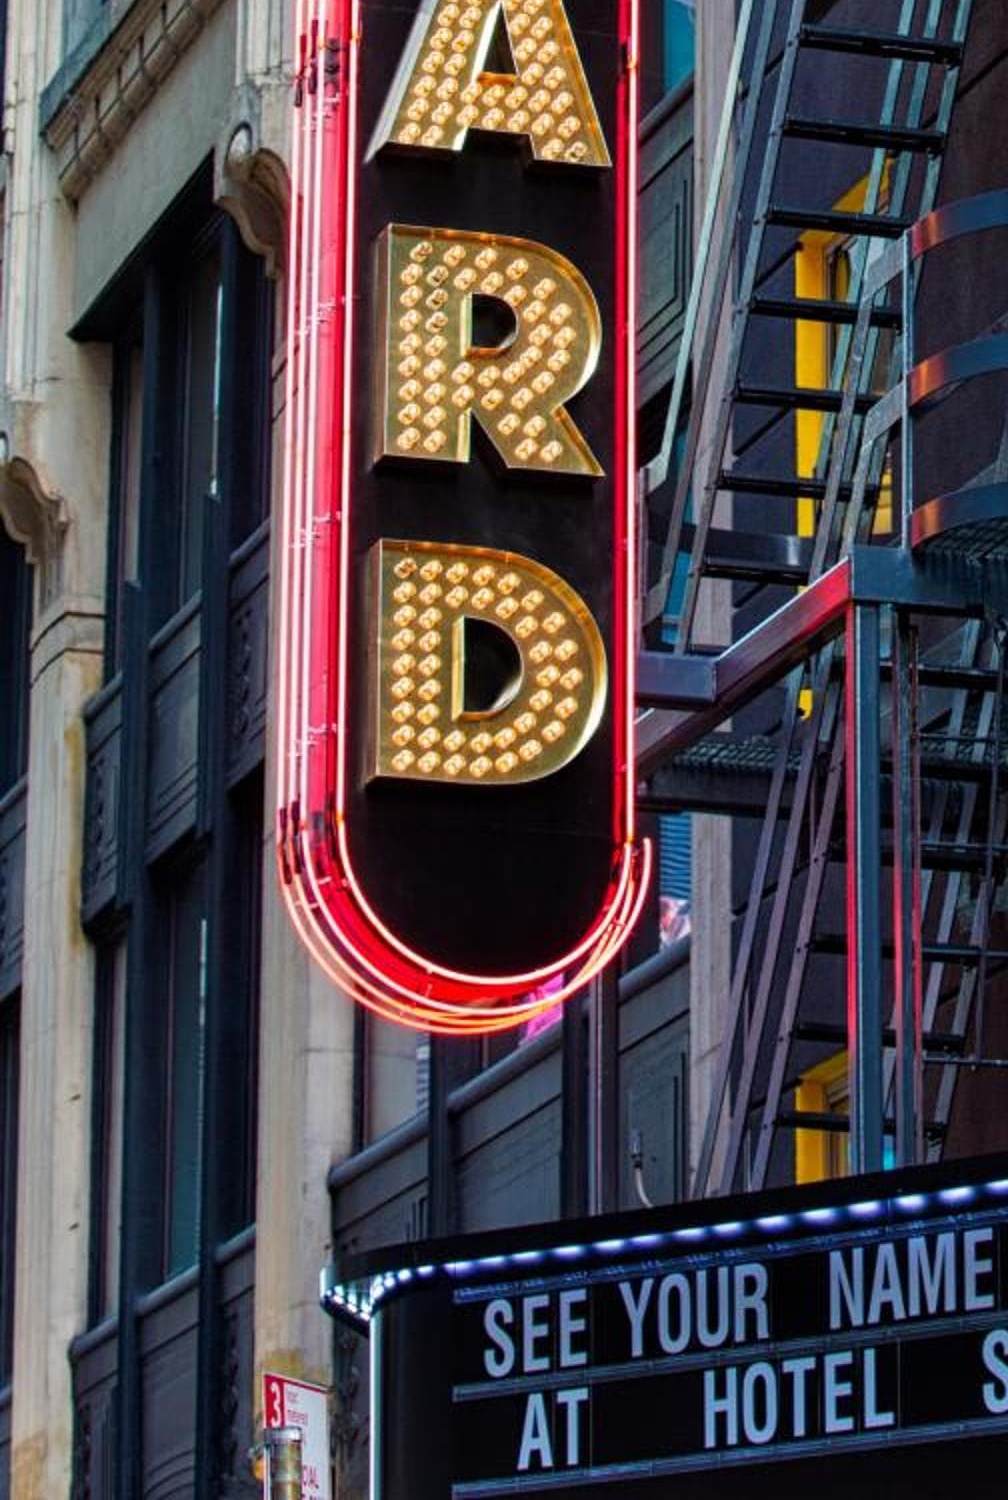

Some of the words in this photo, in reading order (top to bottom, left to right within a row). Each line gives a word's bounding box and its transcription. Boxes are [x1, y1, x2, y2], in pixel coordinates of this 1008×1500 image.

[484, 1288, 587, 1378] SEE
[619, 1263, 770, 1357] YOUR
[829, 1228, 995, 1330] NAME
[516, 1388, 589, 1471] AT
[704, 1348, 895, 1449] HOTEL
